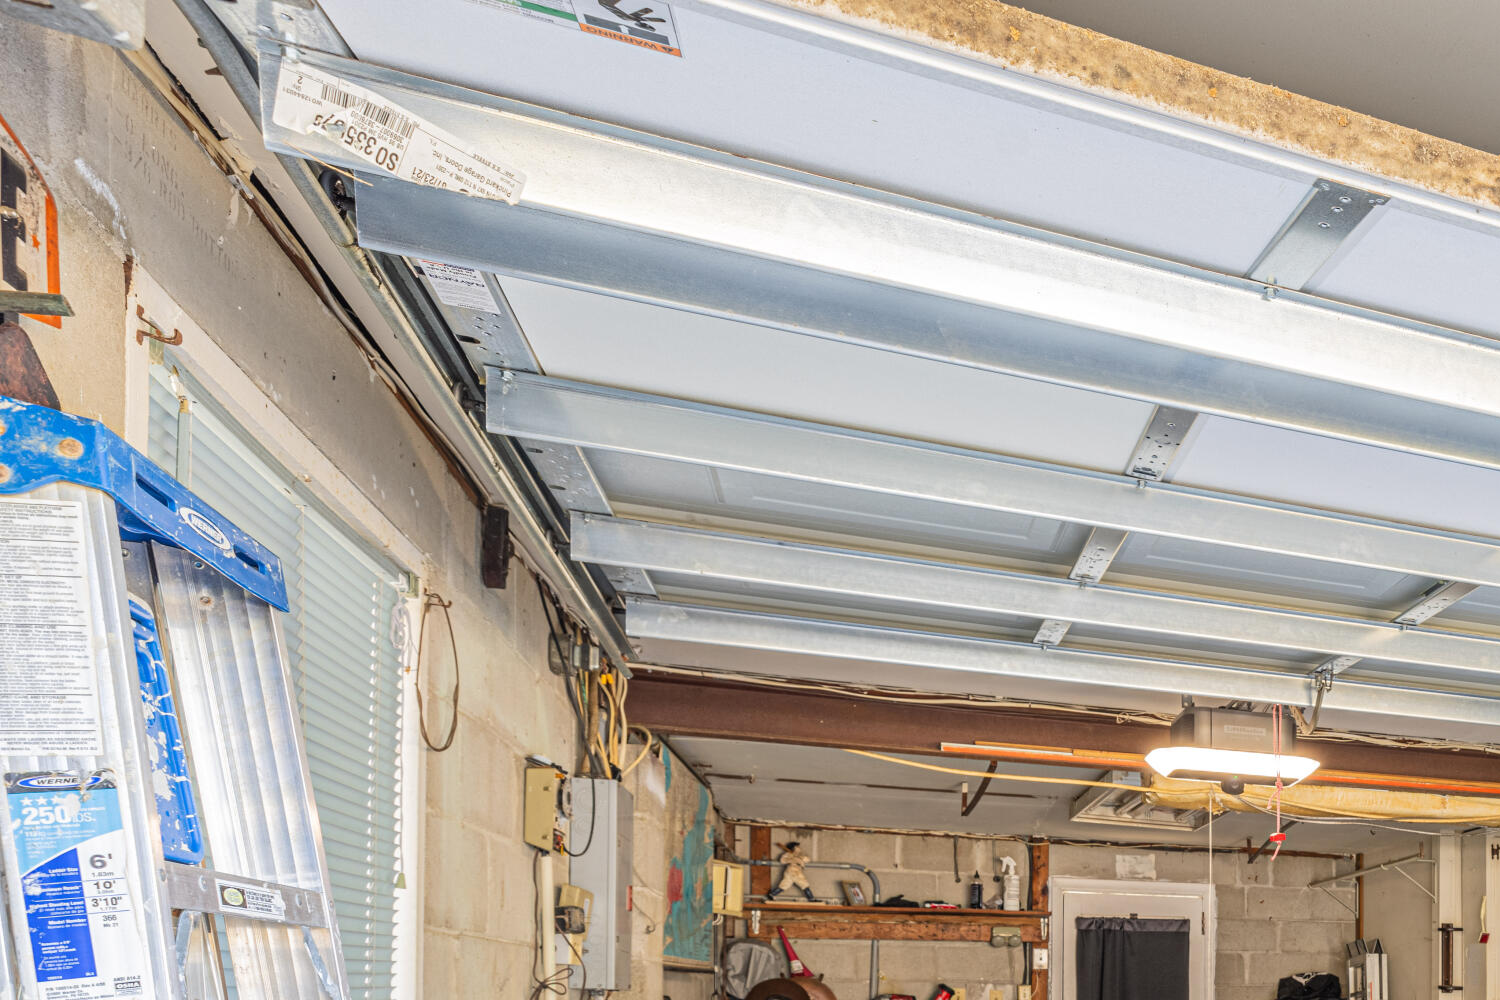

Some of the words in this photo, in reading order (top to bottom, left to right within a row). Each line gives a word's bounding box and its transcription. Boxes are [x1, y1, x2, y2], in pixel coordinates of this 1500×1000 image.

[464, 166, 485, 184] Garage
[37, 777, 80, 786] WERNE
[22, 806, 70, 826] 250
[89, 853, 113, 870] 6'
[93, 880, 116, 890] 10'
